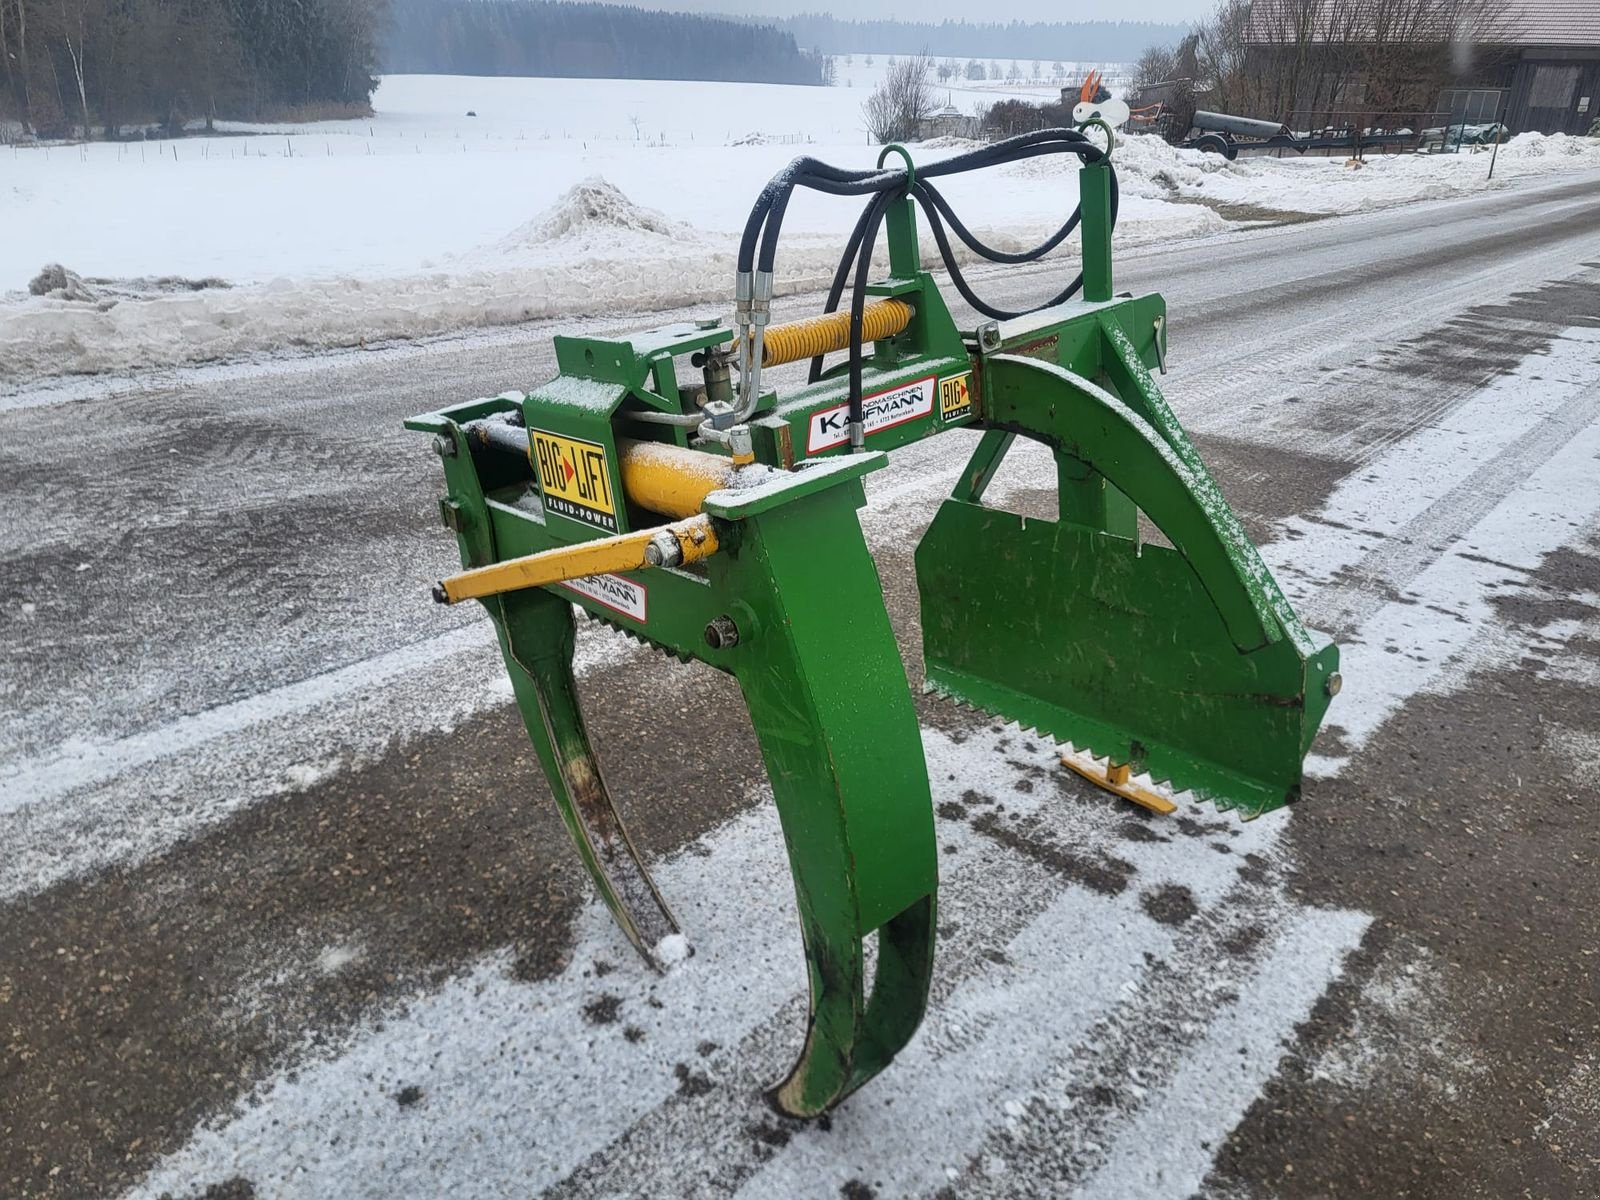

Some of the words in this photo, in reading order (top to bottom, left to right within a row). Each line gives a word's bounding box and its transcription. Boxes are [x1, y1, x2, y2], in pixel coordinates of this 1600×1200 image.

[943, 380, 961, 408] BIG
[535, 437, 567, 493] BIG
[570, 446, 610, 507] LIFT
[547, 497, 615, 529] FLUID-POWER
